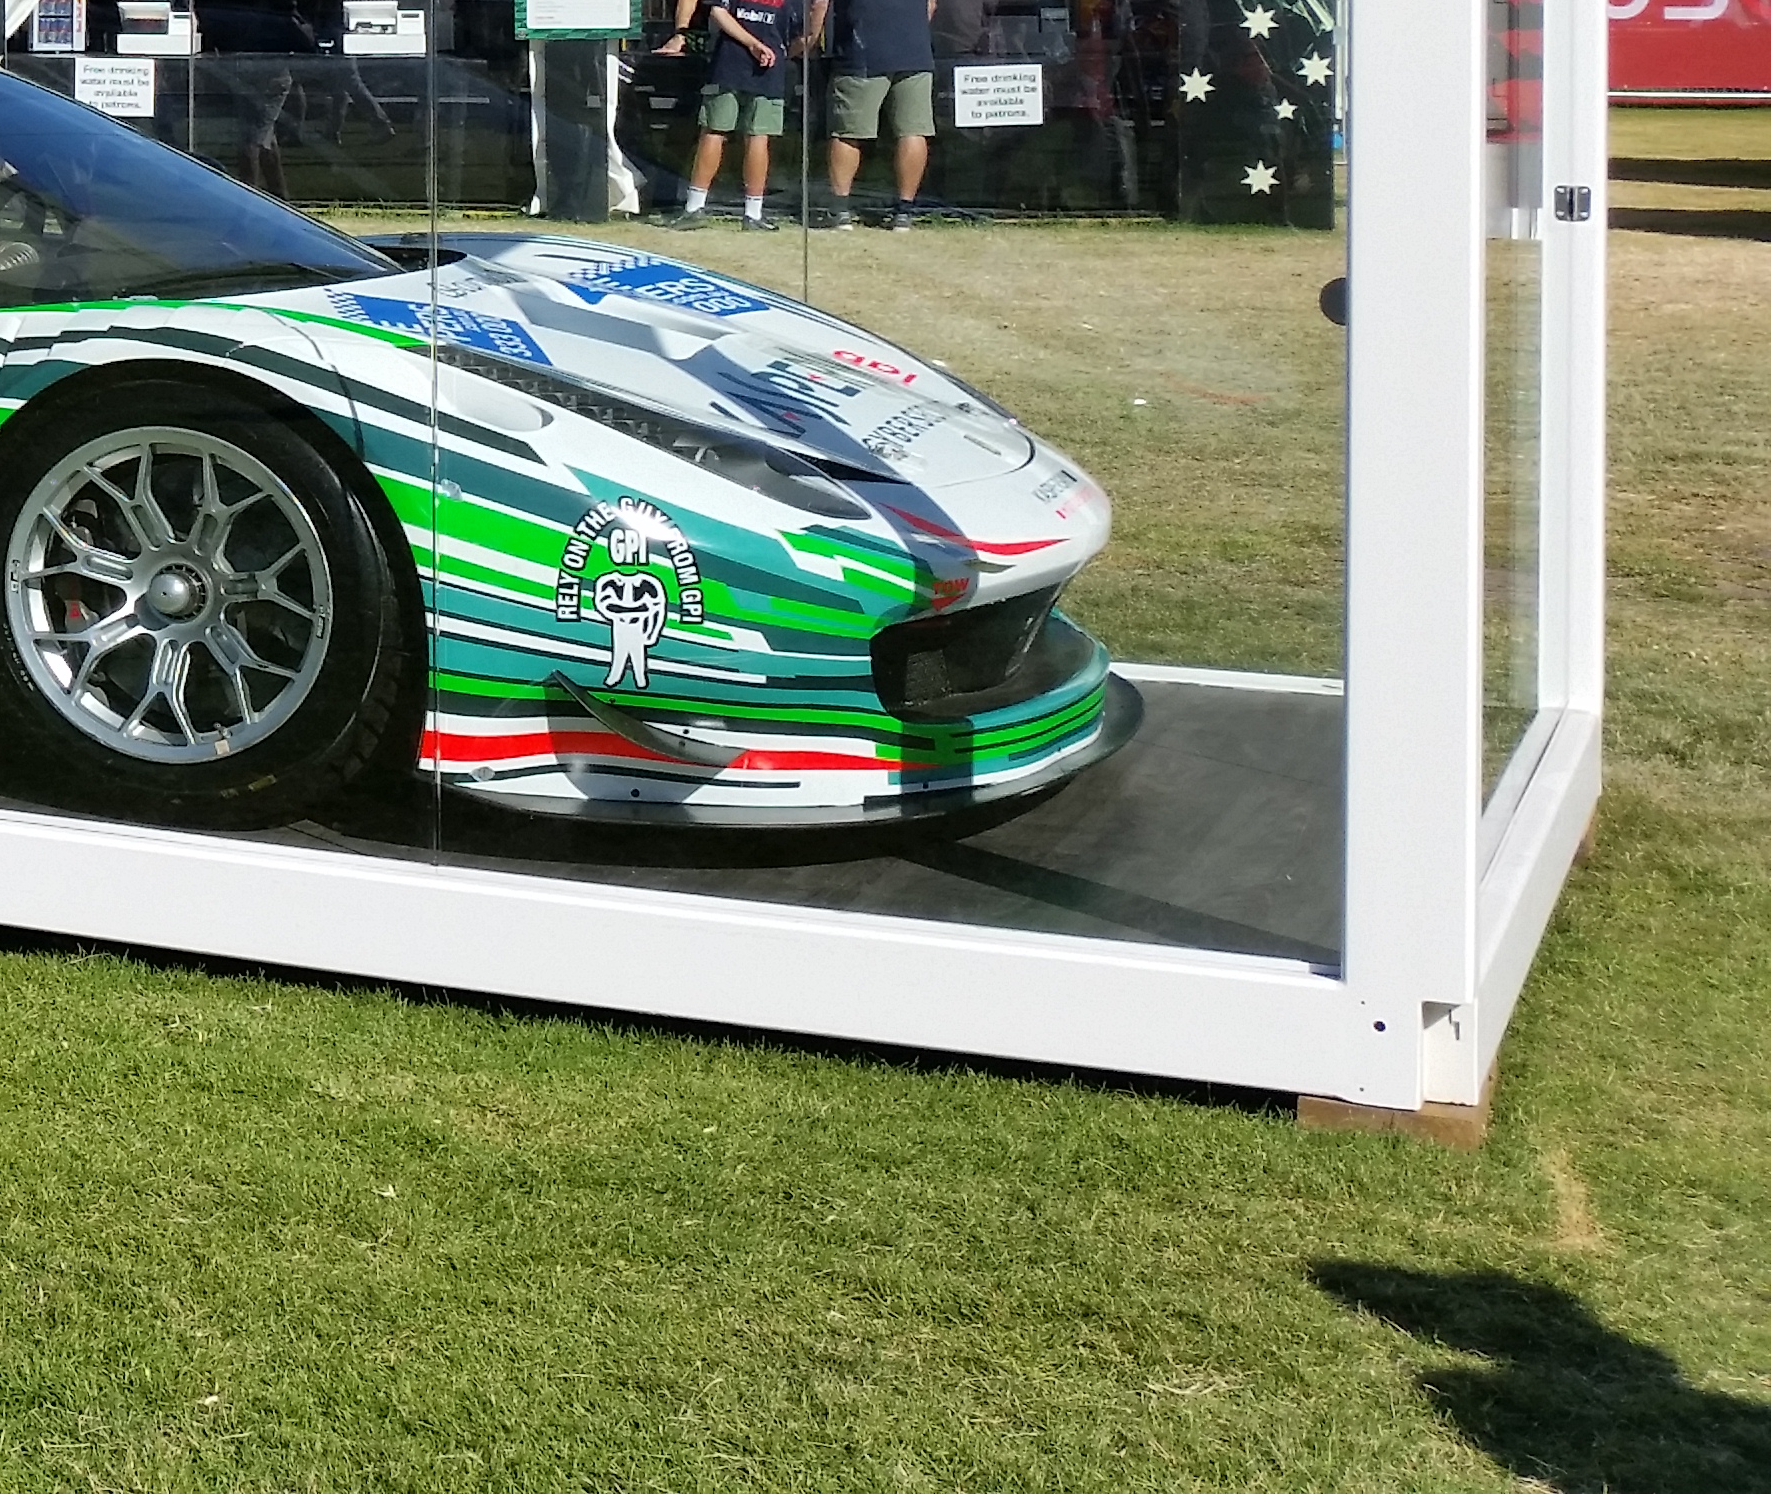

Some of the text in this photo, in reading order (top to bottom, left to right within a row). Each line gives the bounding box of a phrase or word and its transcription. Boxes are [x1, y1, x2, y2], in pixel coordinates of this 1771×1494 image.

[562, 537, 592, 570] ON
[609, 527, 649, 566] GPI
[557, 570, 580, 622] RELY
[680, 588, 703, 624] GPI
